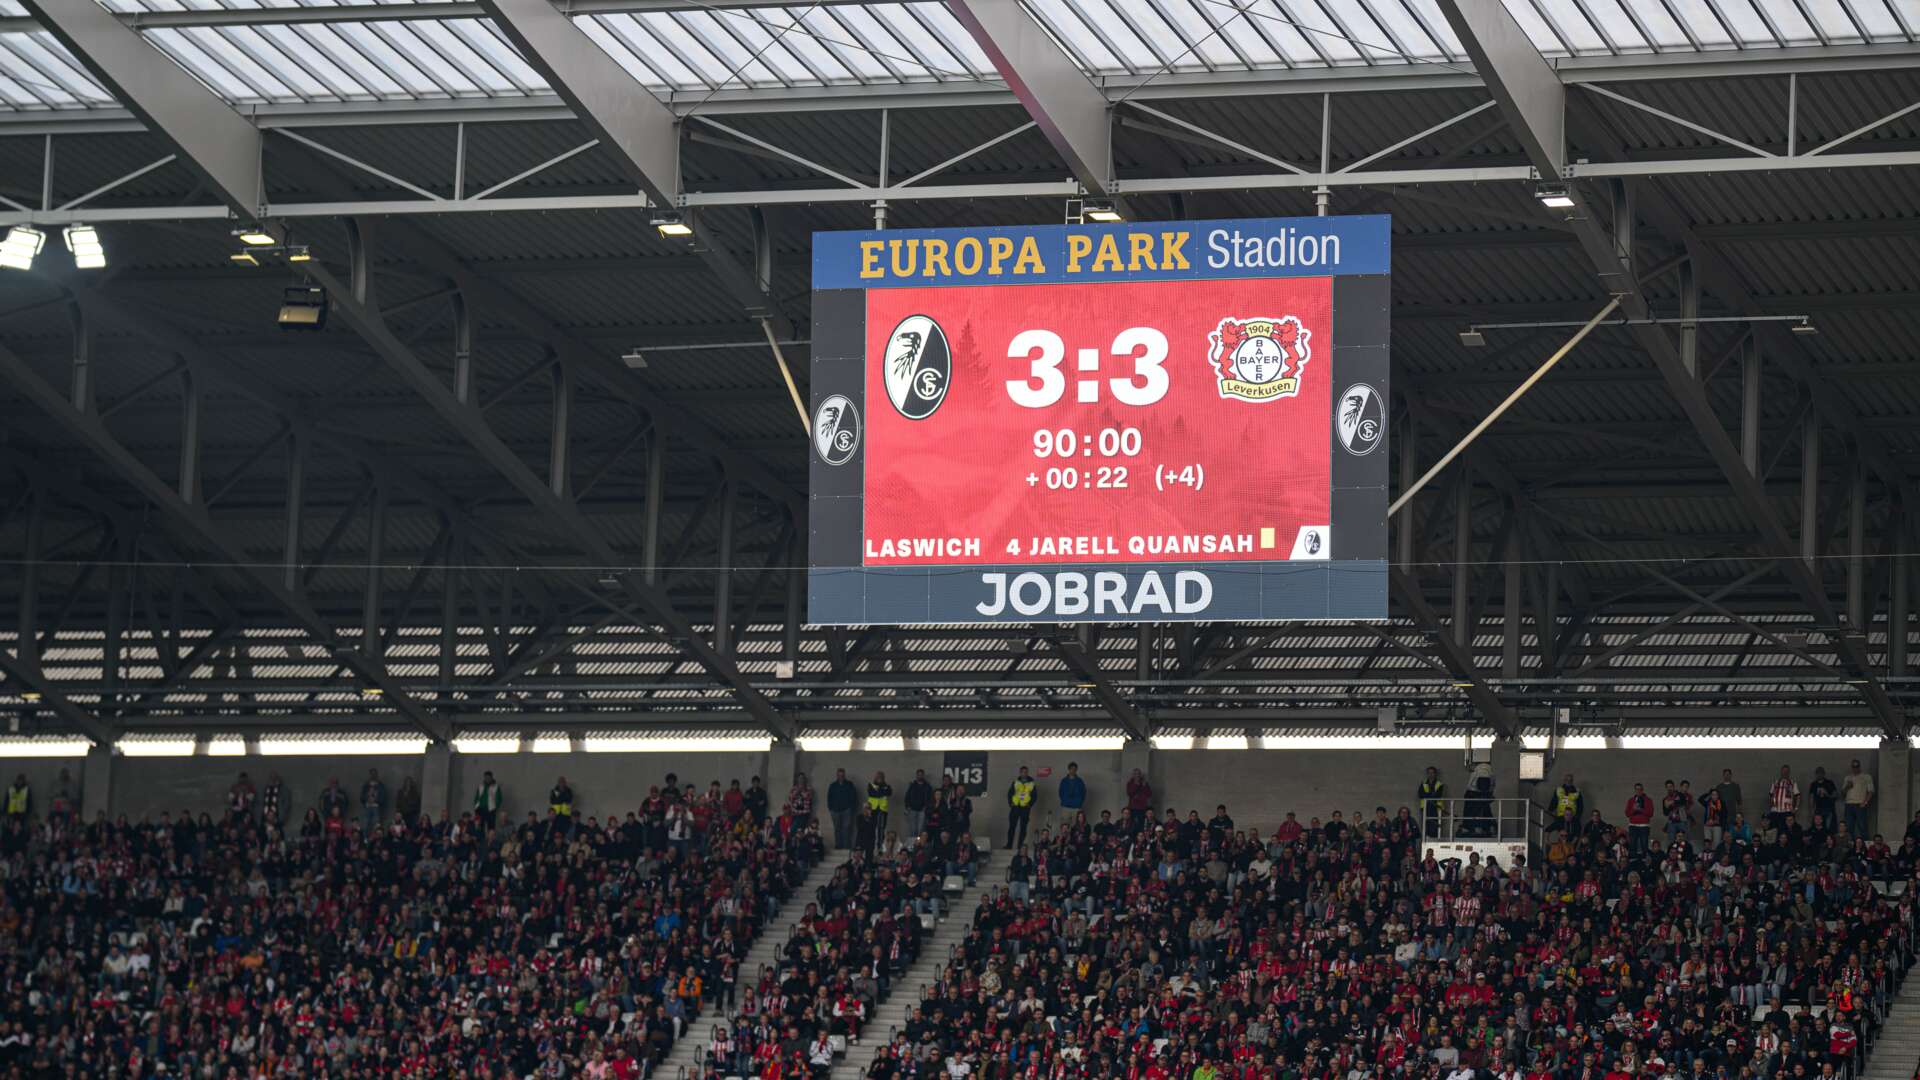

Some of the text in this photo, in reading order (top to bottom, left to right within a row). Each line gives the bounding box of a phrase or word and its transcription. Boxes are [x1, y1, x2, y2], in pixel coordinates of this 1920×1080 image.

[860, 227, 1340, 279] EUROPA PARK Stadion
[1248, 325, 1271, 335] 1904
[1005, 327, 1170, 409] 3:3
[1239, 355, 1279, 365] BAYER
[1255, 339, 1263, 381] BAYER
[1227, 382, 1291, 396] Leverkusen
[1033, 427, 1142, 458] 90:00
[1155, 464, 1204, 491] (+4)
[865, 534, 1253, 558] LASWICH 4 JARELL QUANSAH
[975, 570, 1213, 616] JOBRAD
[944, 767, 983, 785] N13
